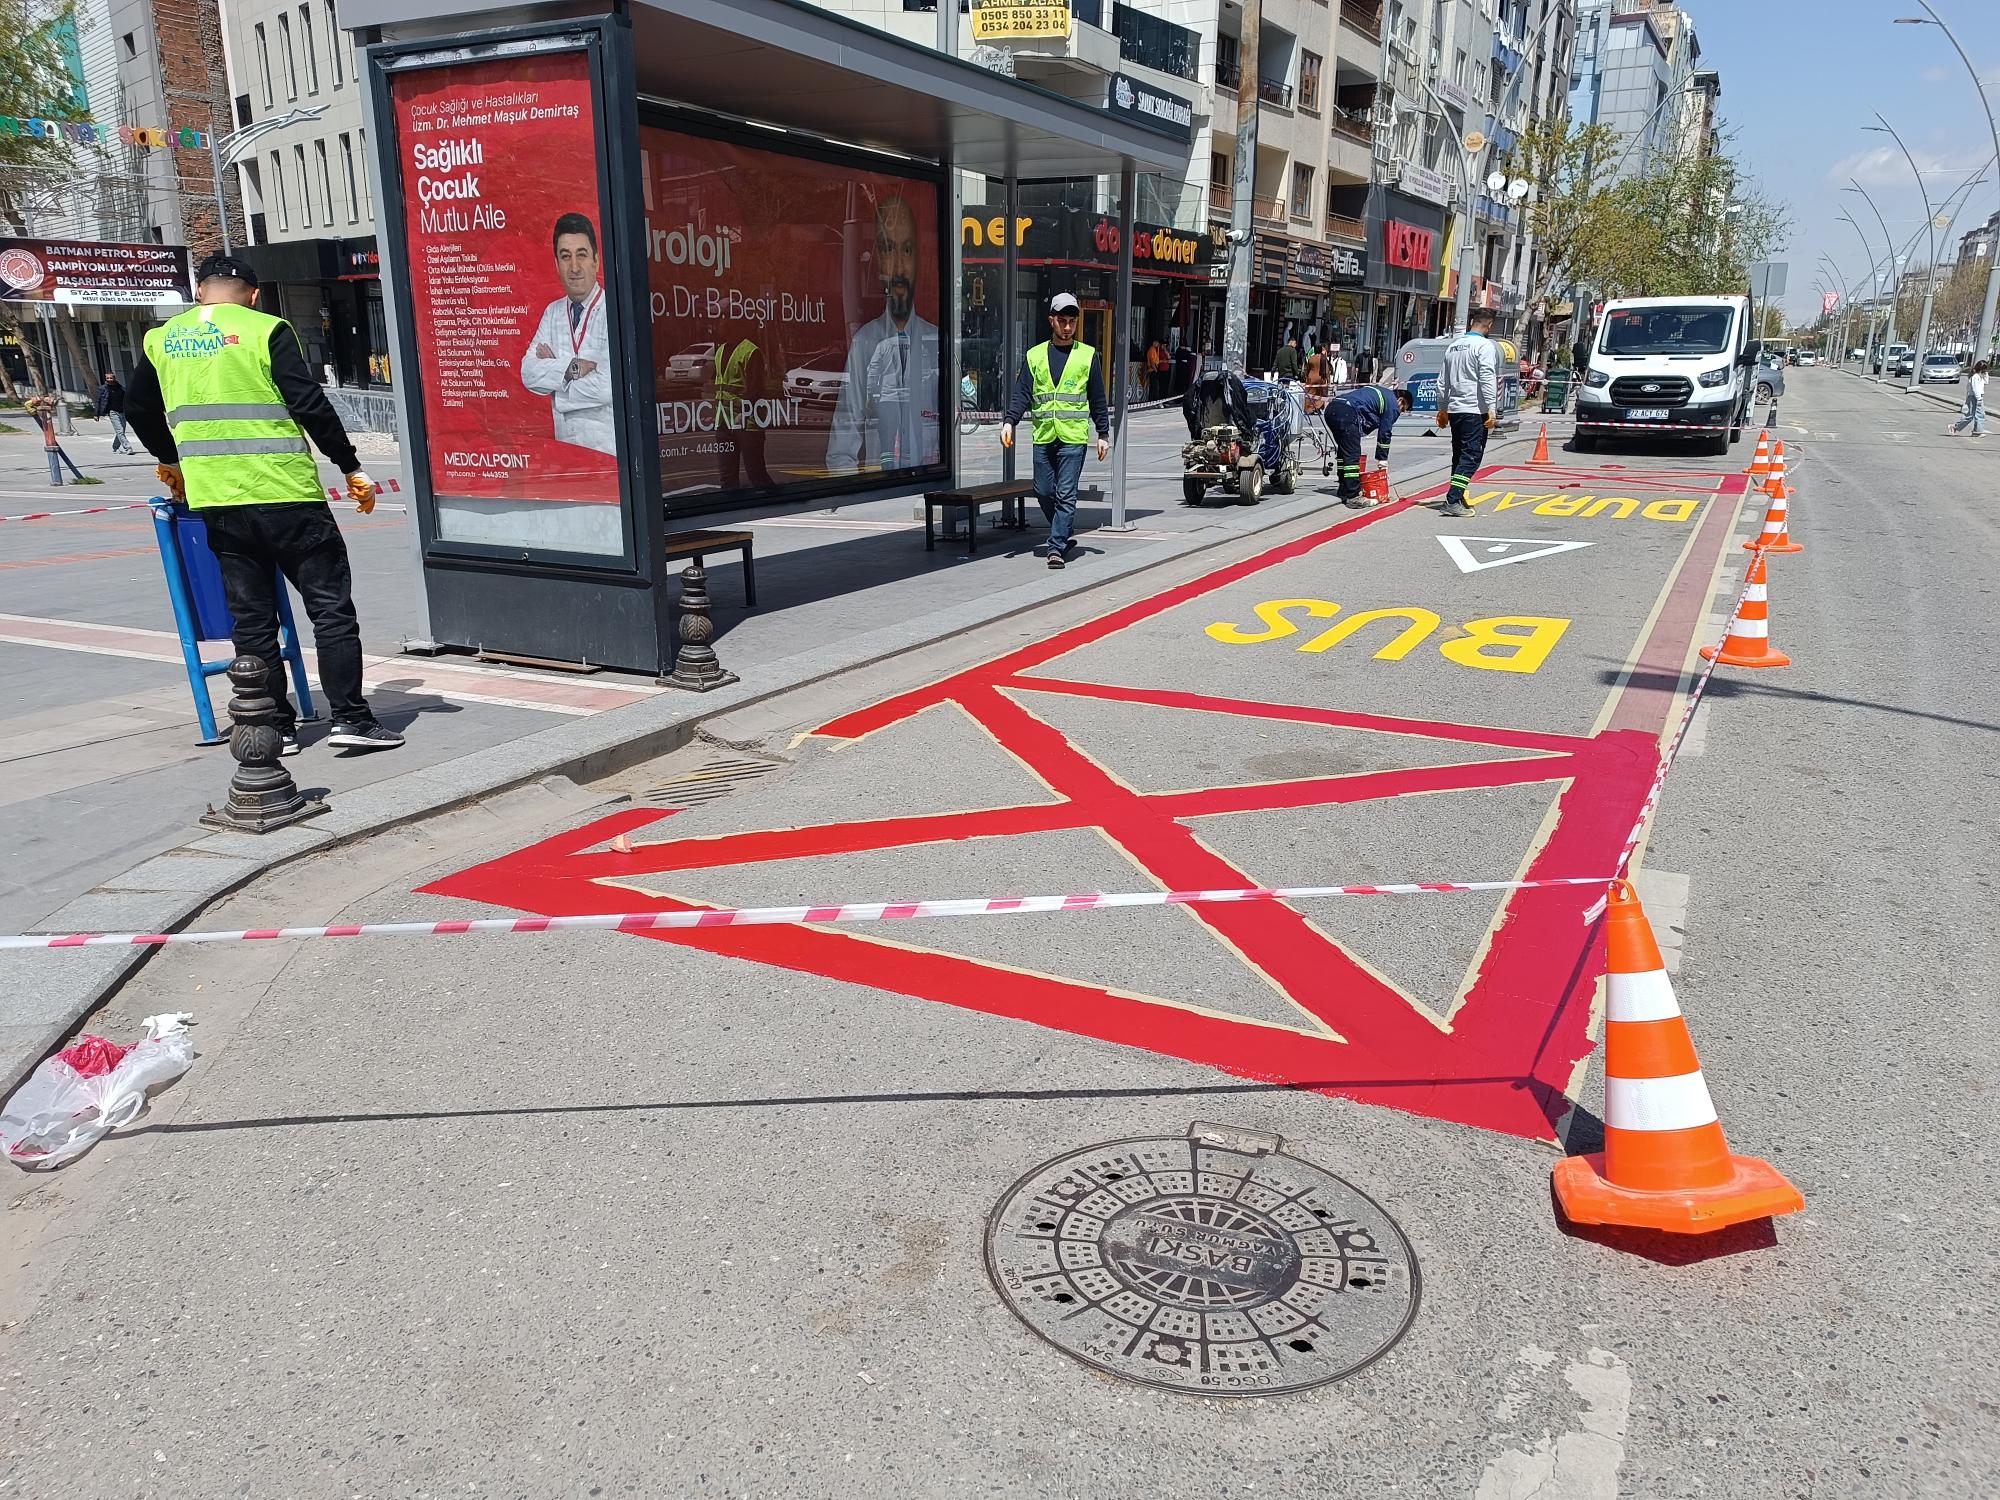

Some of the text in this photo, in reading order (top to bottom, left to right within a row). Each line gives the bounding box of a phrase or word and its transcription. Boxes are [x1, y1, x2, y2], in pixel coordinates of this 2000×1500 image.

[981, 10, 1064, 20] 0505 850 33 11
[982, 20, 1065, 31] 0534 204 23 06
[411, 92, 539, 118] Çocuk Sağlığı ve Hastalıkları
[412, 104, 579, 132] Uzm. Dr. Mehmet Maşuk Demirtaş
[414, 138, 484, 173] Sağlıklı
[417, 172, 480, 209] Çocuk
[420, 204, 506, 234] Mutlu Aile
[46, 246, 92, 257] BATMAN
[95, 250, 137, 259] PETROL
[1153, 228, 1197, 264] döner
[1385, 219, 1434, 272] VESTEL
[56, 276, 174, 288] BAŞARILAR DİLİYORUZ
[673, 285, 703, 318] Dr.
[707, 287, 725, 319] B.
[729, 289, 777, 328] Beşir
[781, 293, 826, 324] Bulut
[164, 335, 224, 353] BATMAN
[444, 452, 530, 469] MEDICALPOINT
[696, 441, 735, 453] 4443525
[1204, 598, 1572, 674] BUS
[1149, 1237, 1252, 1274] BASKI
[1228, 1375, 1271, 1386] GGG
